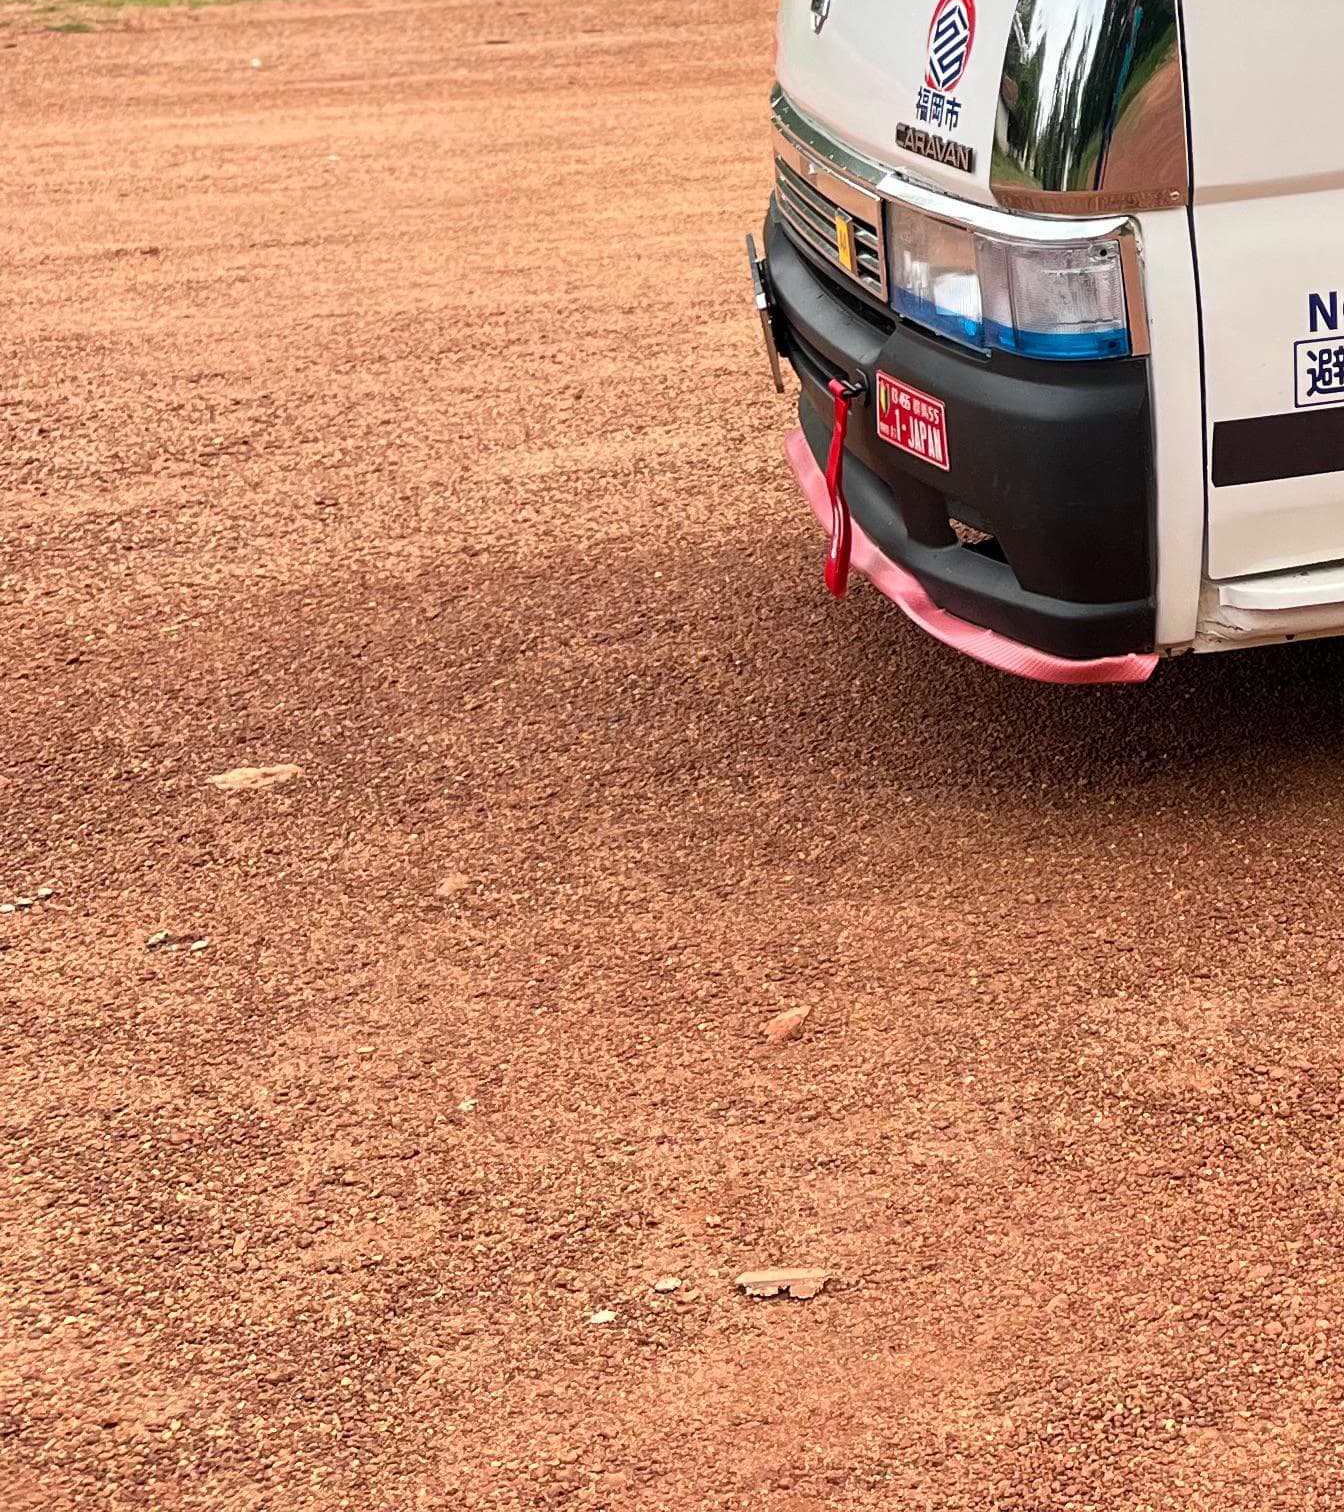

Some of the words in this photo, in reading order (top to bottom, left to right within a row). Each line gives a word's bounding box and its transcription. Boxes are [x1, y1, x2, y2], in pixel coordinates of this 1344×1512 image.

[916, 86, 961, 131] 福岡市
[896, 122, 974, 173] CARAVAN
